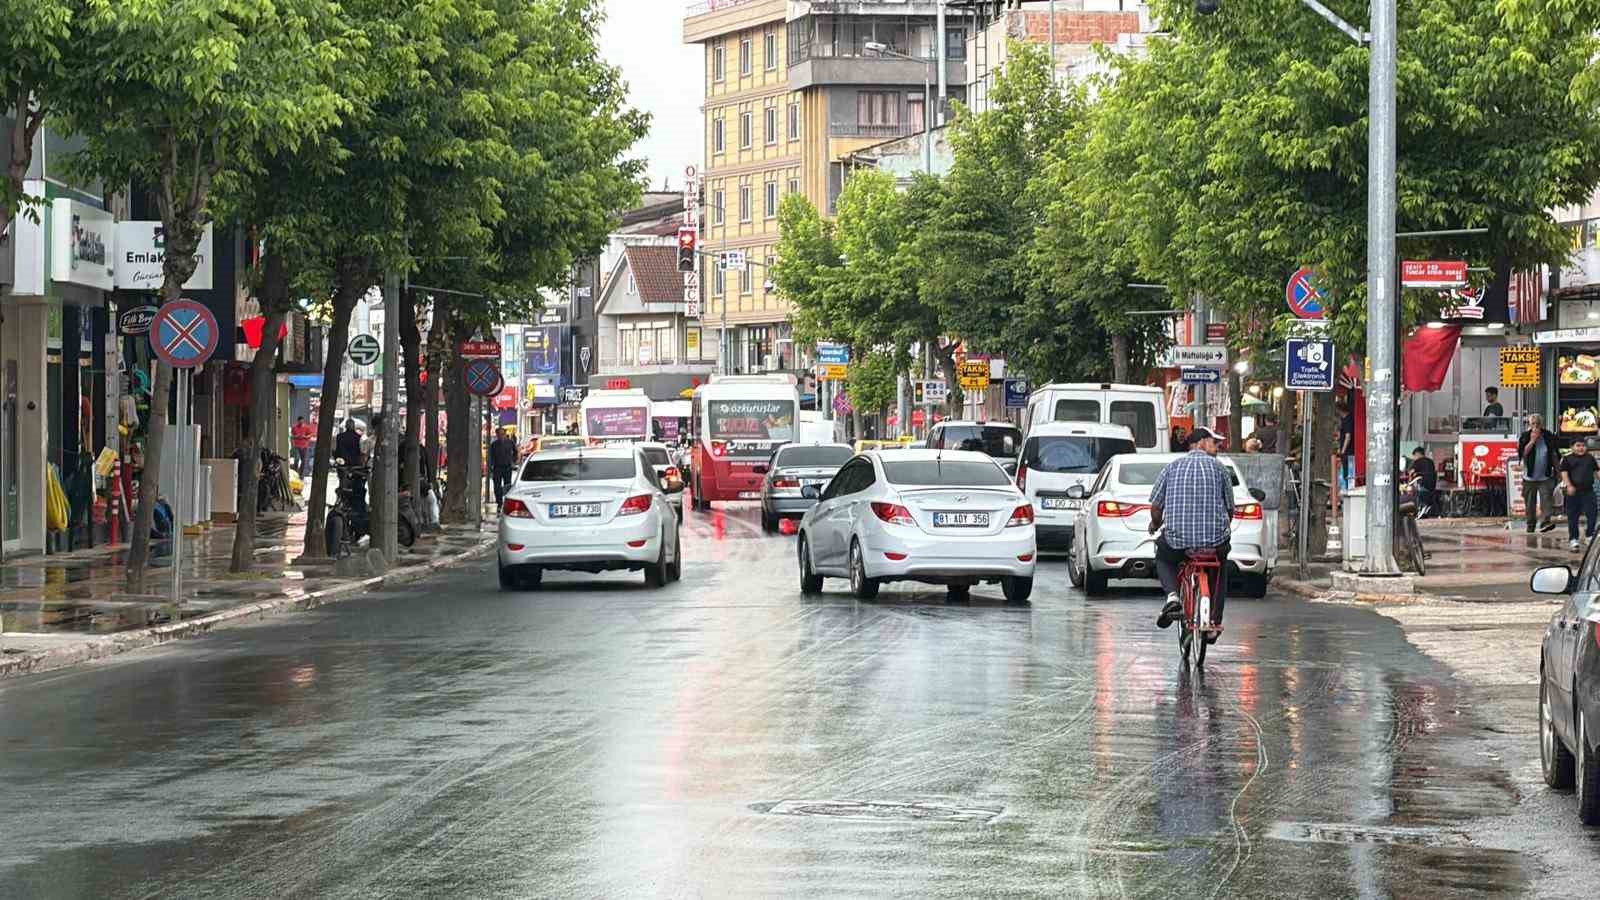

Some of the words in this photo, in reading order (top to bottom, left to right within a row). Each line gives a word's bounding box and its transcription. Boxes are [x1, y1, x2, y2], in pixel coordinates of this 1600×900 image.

[685, 165, 696, 223] OTEL
[126, 252, 165, 263] Emlak
[939, 514, 948, 524] 81
[953, 514, 968, 524] ADY
[973, 514, 987, 524] 356
